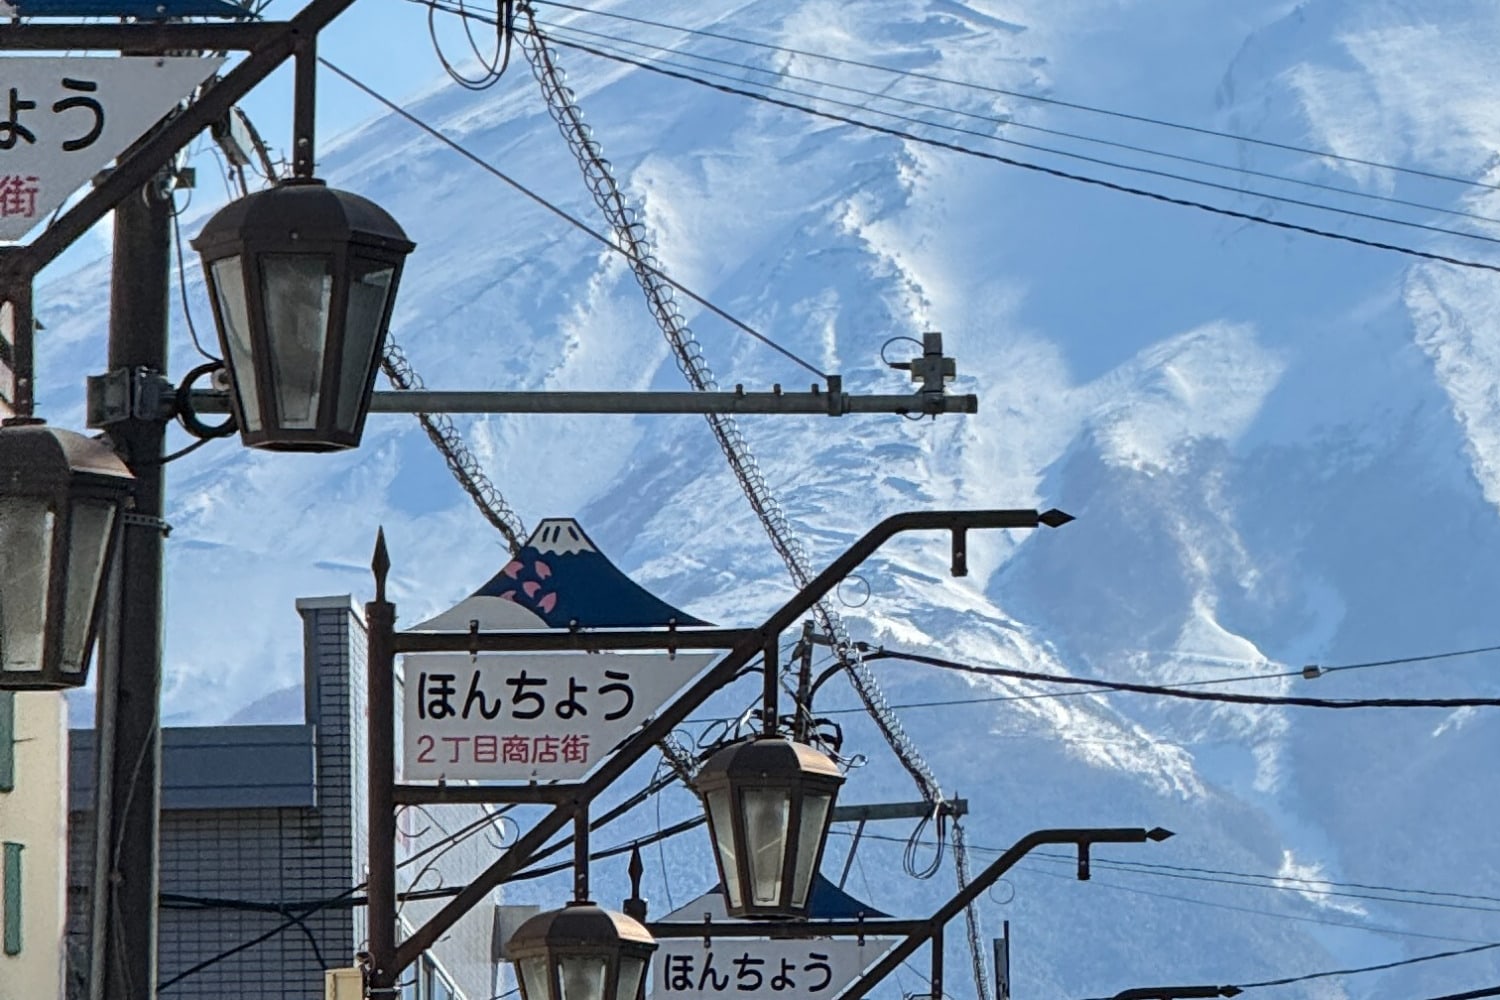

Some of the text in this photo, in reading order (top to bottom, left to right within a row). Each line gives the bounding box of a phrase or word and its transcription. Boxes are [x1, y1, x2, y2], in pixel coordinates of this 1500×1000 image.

[0, 78, 105, 151] ょう
[0, 175, 39, 218] 街
[418, 670, 634, 721] ほんちょう
[417, 734, 590, 764] 2丁目商店街
[664, 952, 832, 992] ほんちょう
